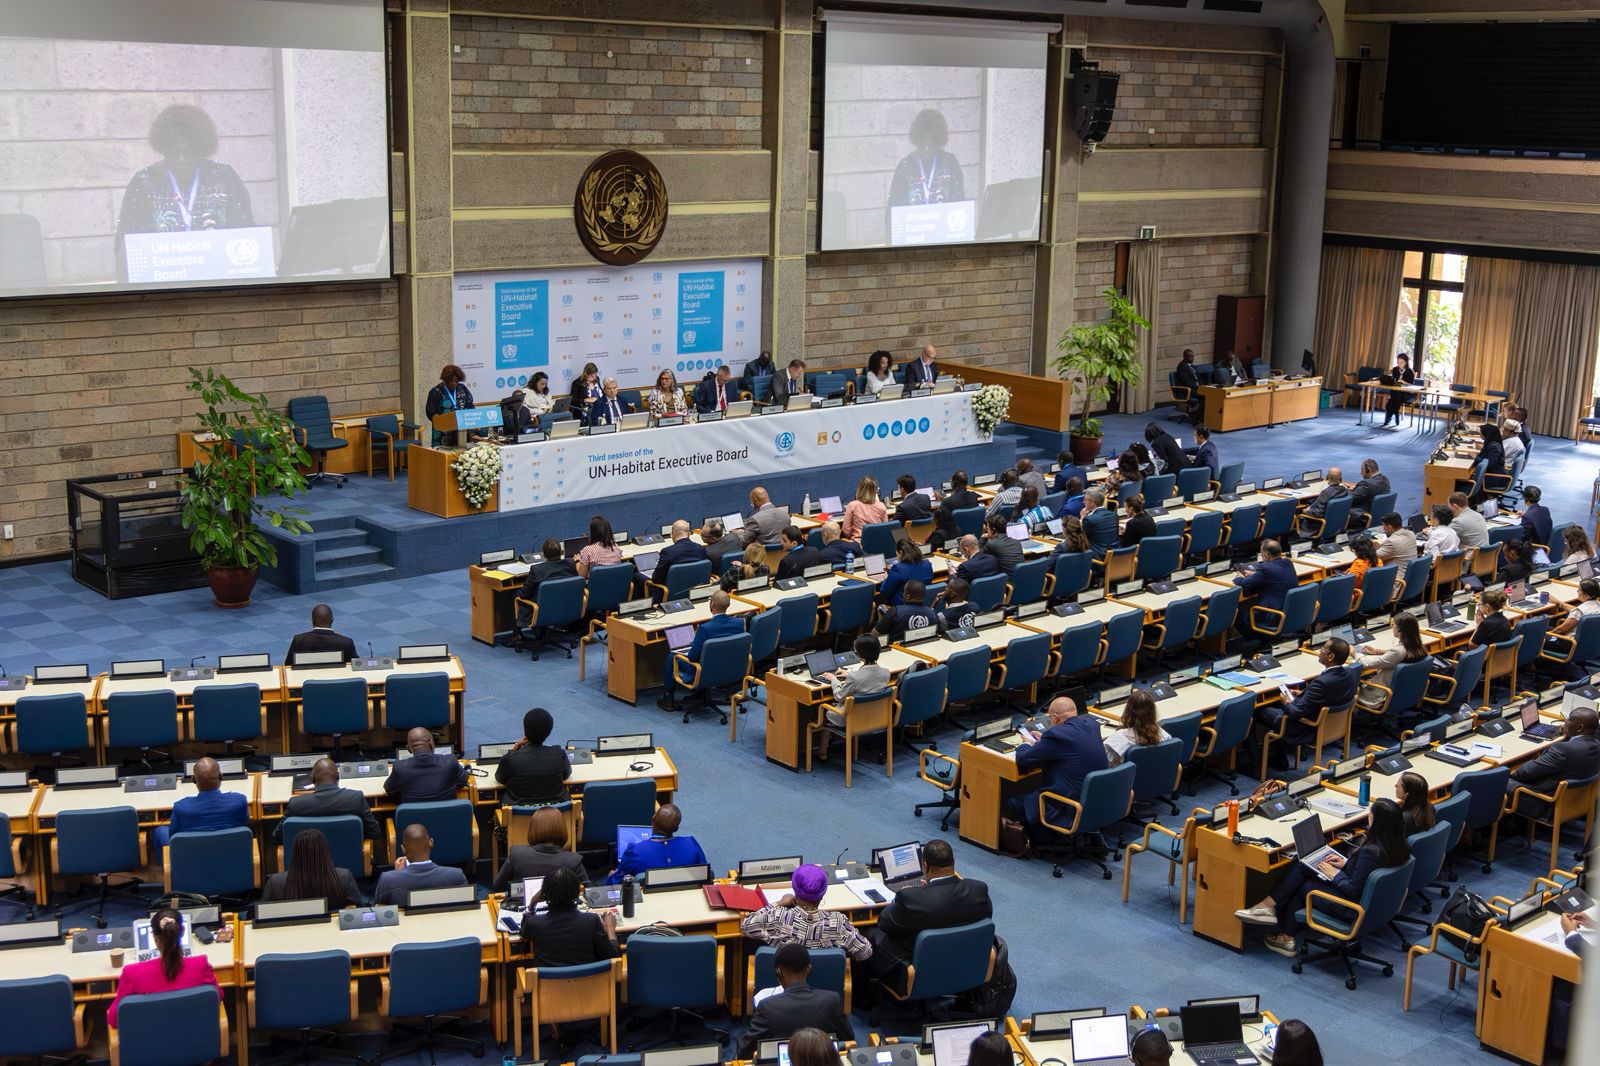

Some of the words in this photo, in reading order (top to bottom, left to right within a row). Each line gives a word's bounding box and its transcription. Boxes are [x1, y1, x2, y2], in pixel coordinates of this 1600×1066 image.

[154, 269, 187, 280] Board
[683, 283, 715, 291] UN-Habitat
[501, 293, 537, 302] UN-Habitat
[683, 292, 711, 300] Executive
[501, 303, 533, 312] Executive
[683, 300, 700, 309] Board
[501, 312, 521, 321] Board
[588, 454, 606, 463] Third
[607, 451, 633, 462] session
[634, 448, 642, 457] of
[643, 447, 654, 456] the
[588, 459, 655, 479] UN-Habitat
[658, 452, 713, 470] Executive
[716, 446, 748, 462] Board
